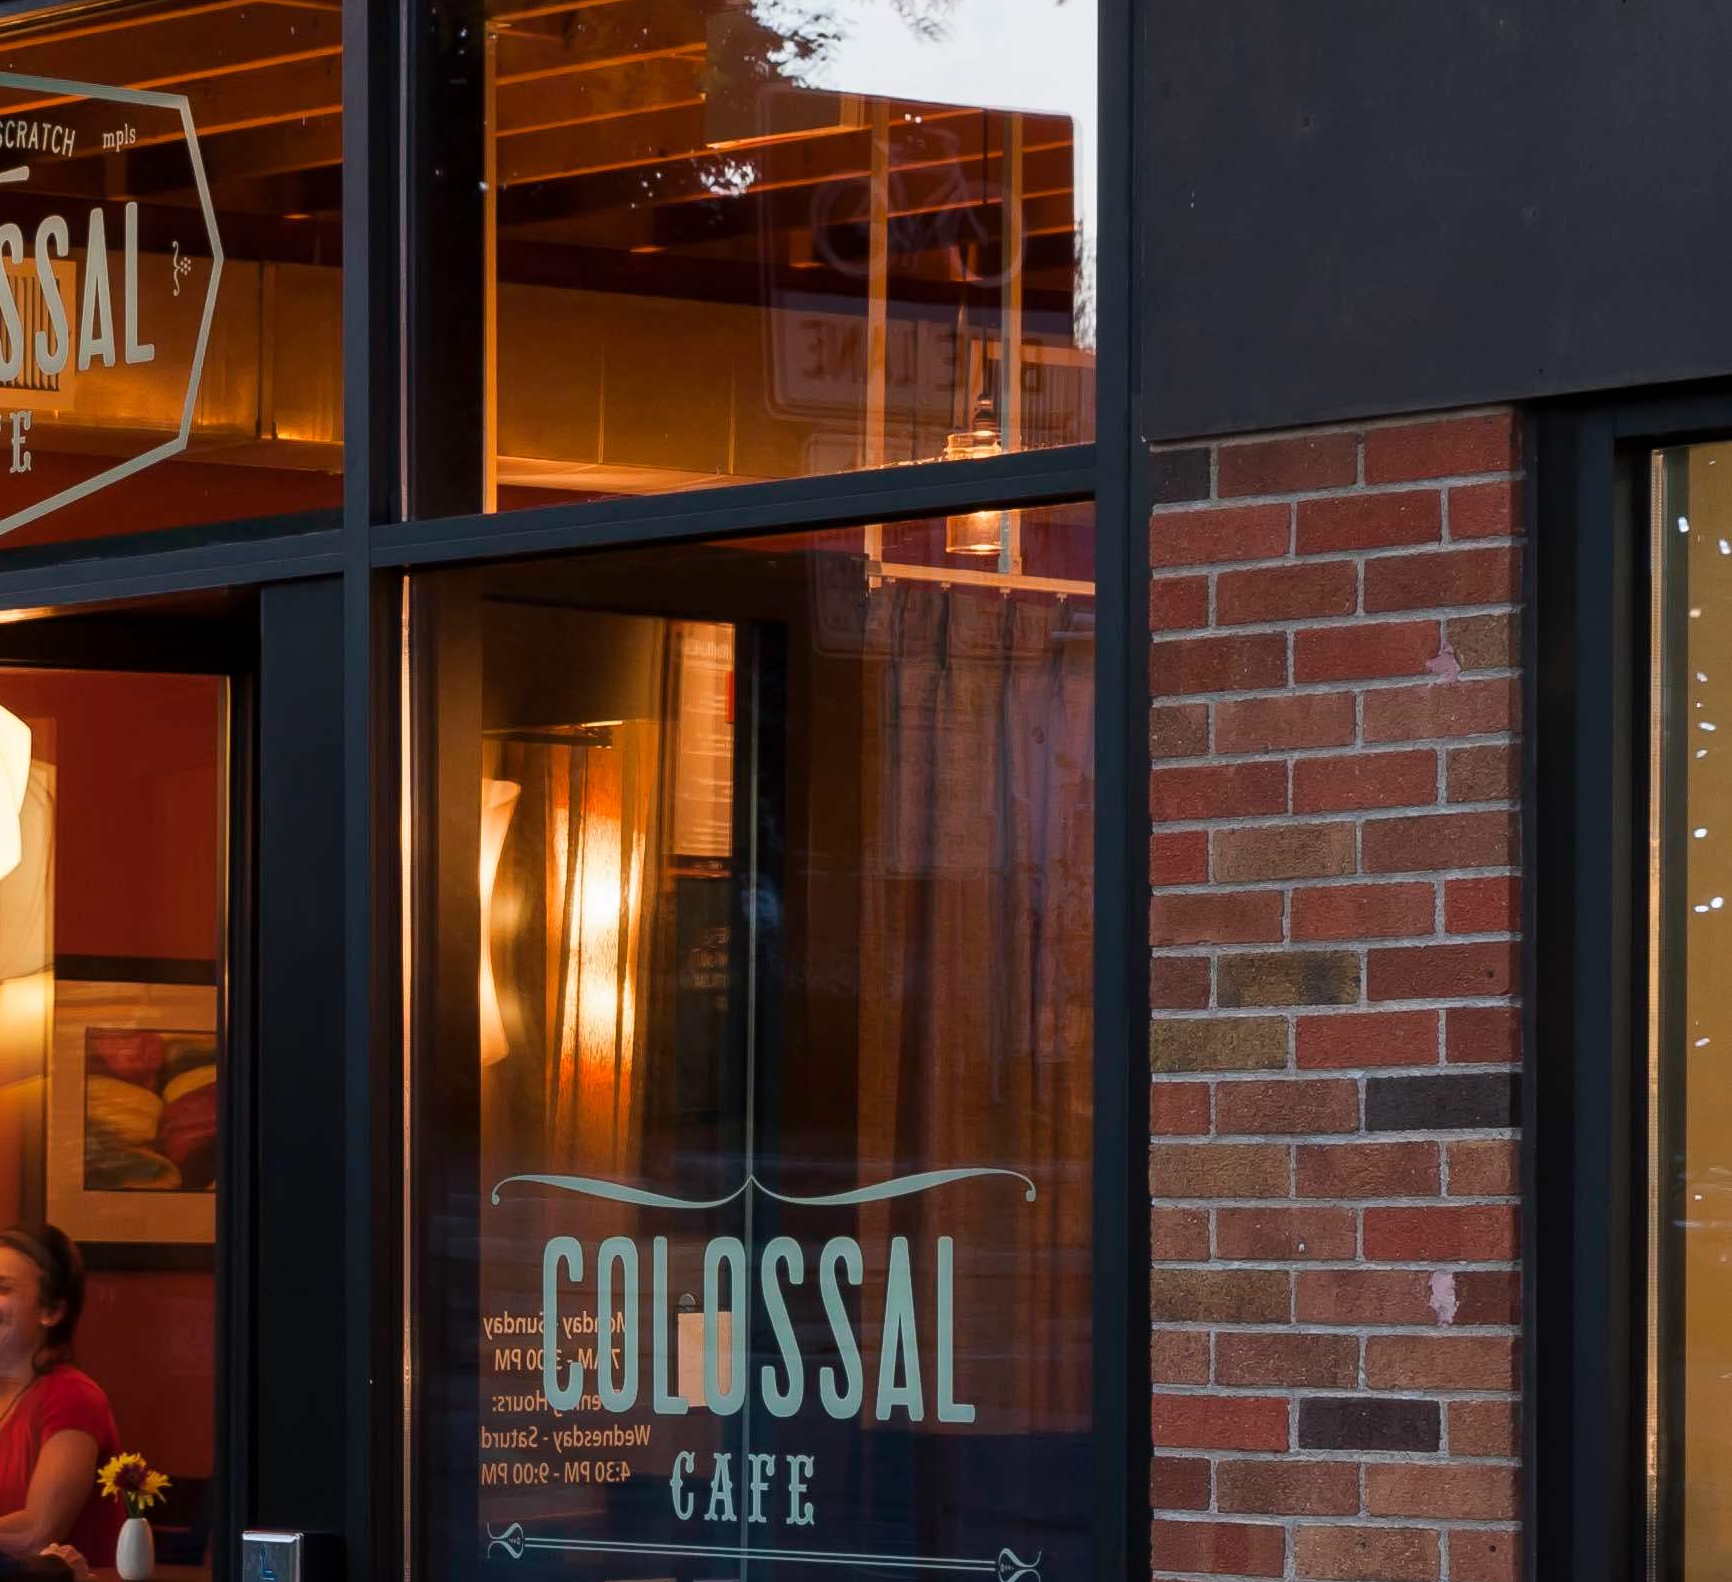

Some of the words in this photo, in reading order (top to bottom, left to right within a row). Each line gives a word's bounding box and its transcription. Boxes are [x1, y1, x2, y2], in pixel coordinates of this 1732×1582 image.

[102, 123, 136, 152] mpls
[542, 1236, 976, 1422] COLOSSAL
[670, 1450, 815, 1526] CAFE
